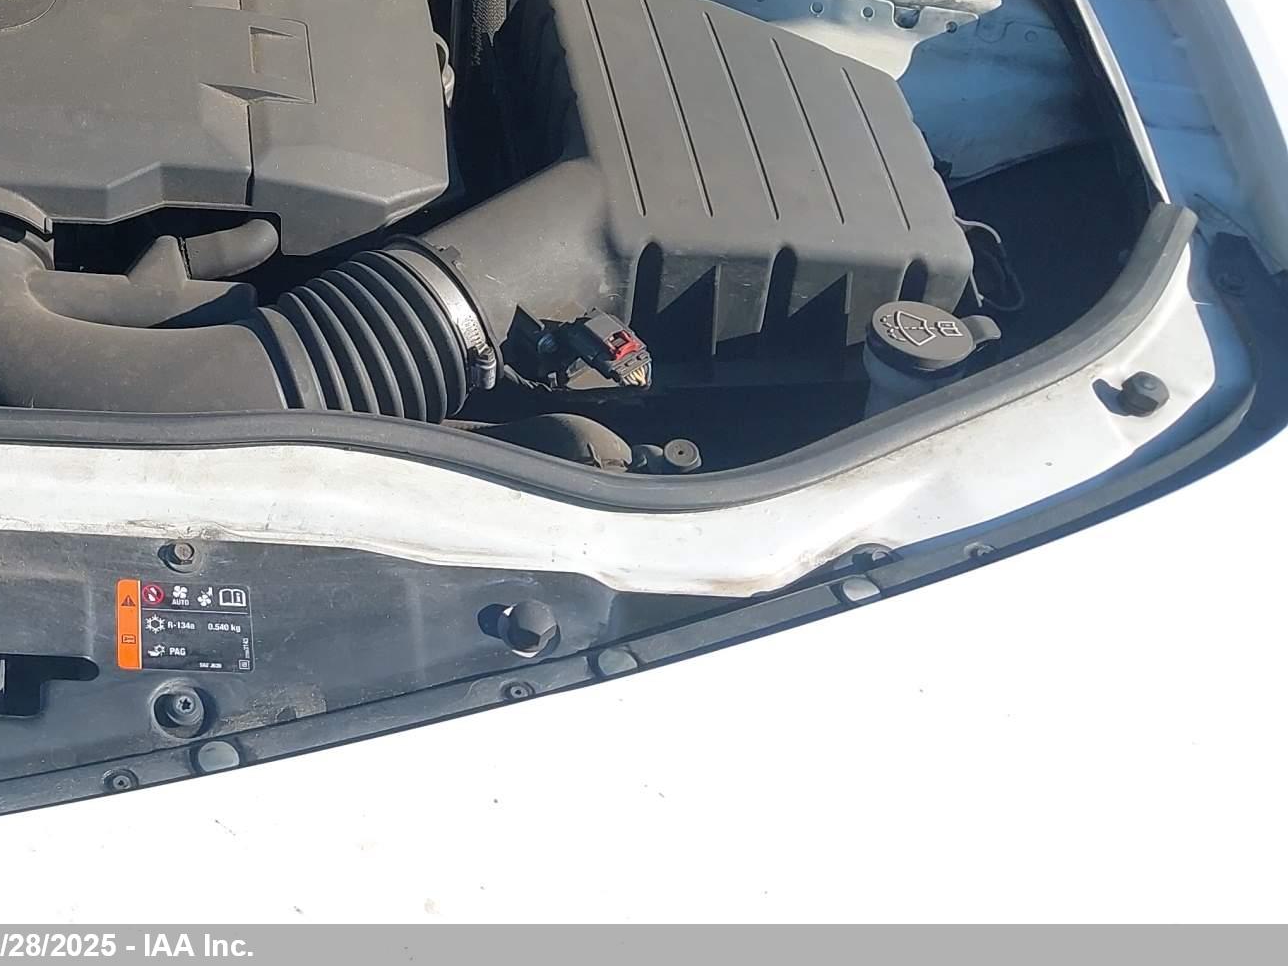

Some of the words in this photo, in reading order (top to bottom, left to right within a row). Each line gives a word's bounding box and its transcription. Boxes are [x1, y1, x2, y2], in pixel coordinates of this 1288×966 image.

[167, 621, 196, 630] R-134a
[207, 622, 230, 632] 0.540
[230, 623, 242, 634] kg
[169, 647, 187, 656] PAG
